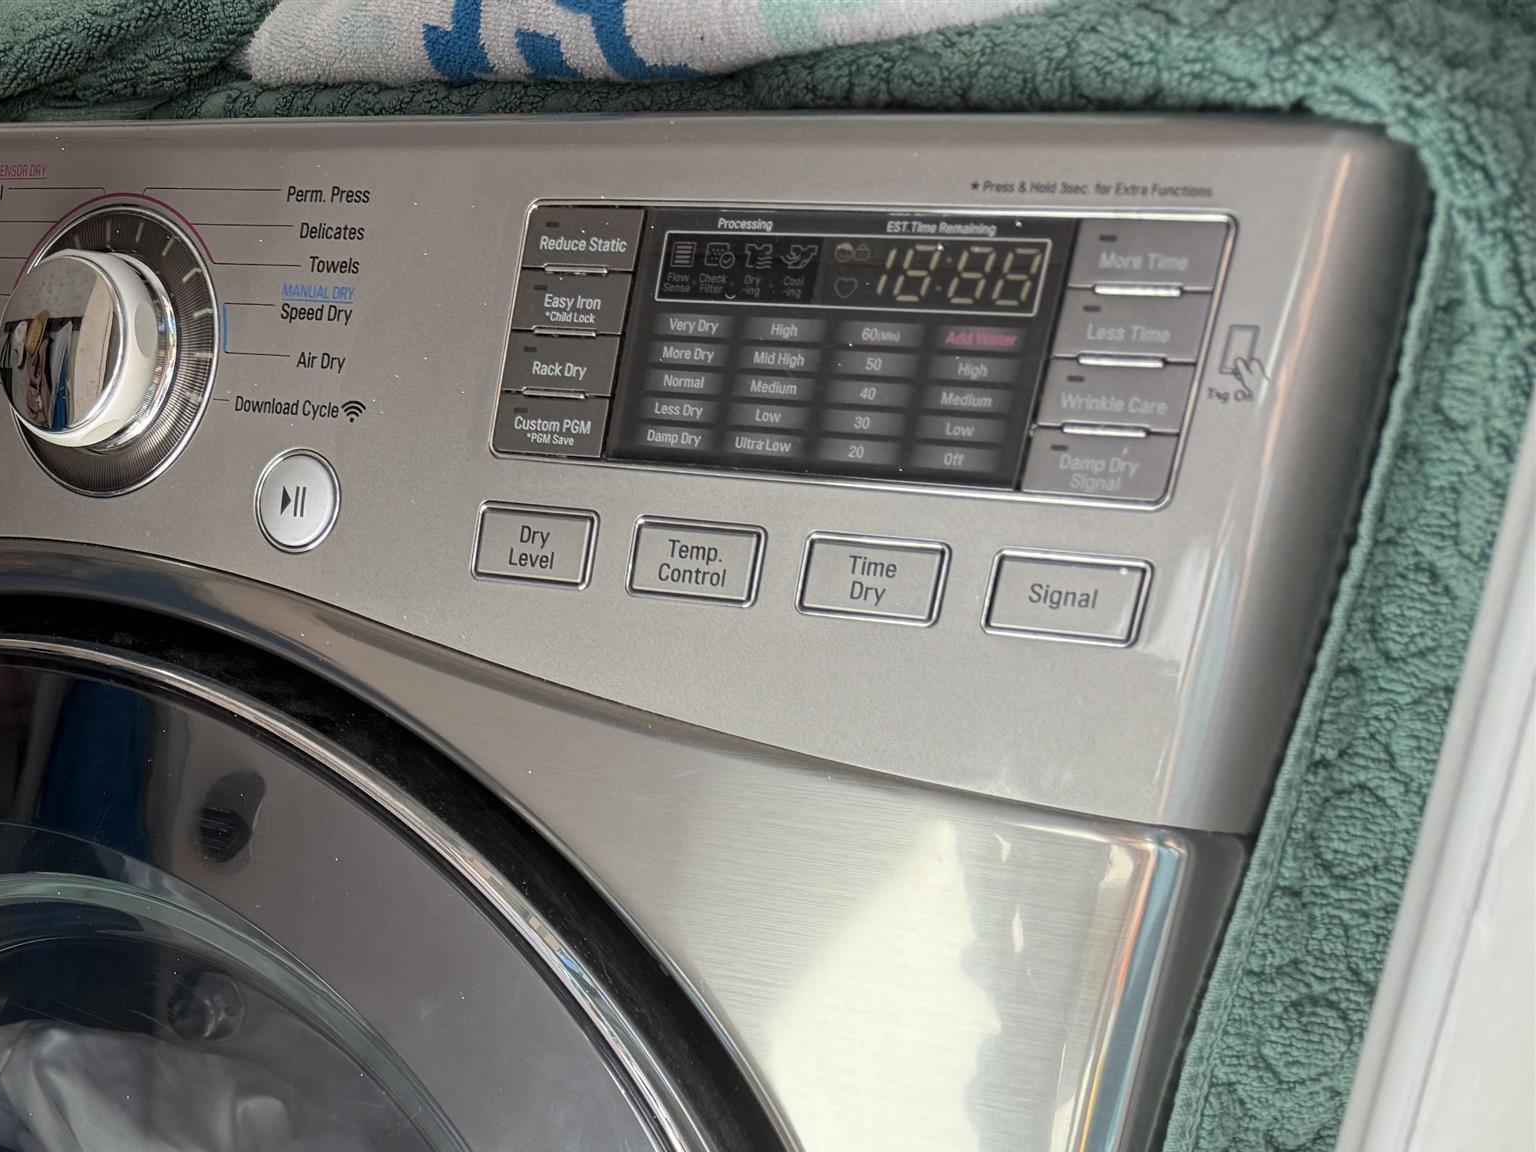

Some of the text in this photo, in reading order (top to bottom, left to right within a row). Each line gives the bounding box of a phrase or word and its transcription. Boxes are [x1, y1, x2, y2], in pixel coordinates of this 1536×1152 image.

[30, 162, 47, 177] DRY
[286, 185, 371, 204] Perm. Press
[982, 180, 1015, 193] Press
[1017, 181, 1027, 193] &
[1114, 183, 1148, 197] Extra
[1151, 183, 1213, 198] Functions
[299, 222, 366, 241] Delicates
[717, 217, 774, 233] Processing
[886, 220, 997, 237] EST. Time Remaining
[539, 235, 628, 254] Reduce Static
[309, 255, 361, 275] Towels
[1099, 251, 1189, 272] More Time
[282, 283, 356, 301] MANUAL DRY
[544, 293, 602, 311] Easy Iron
[280, 302, 353, 326] Speed Dry
[573, 311, 595, 324] Lock
[669, 318, 719, 335] Very Dry
[770, 322, 798, 341] High
[1086, 322, 1171, 343] Less Time
[296, 351, 346, 374] Air Dry
[662, 346, 714, 364] More Dry
[753, 351, 805, 369] Mid High
[531, 360, 587, 380] Rack Dry
[865, 358, 882, 372] 50
[957, 362, 989, 380] High
[663, 375, 705, 390] Normal
[750, 380, 797, 395] Medium
[859, 387, 877, 401] 40
[940, 391, 993, 407] Medium
[235, 395, 339, 420] Download Cycle
[654, 402, 704, 420] Less Dry
[1060, 392, 1168, 415] Wrinkle Care
[755, 408, 781, 423] Low
[853, 416, 871, 431] 30
[514, 415, 592, 436] Custom PGM
[945, 422, 974, 437] Low
[551, 434, 575, 446] Save
[647, 429, 702, 448] Damp Dry
[735, 435, 791, 453] Ultra Low
[848, 445, 865, 459] 20
[944, 452, 965, 467] Off
[1058, 454, 1140, 477] Damp Dry
[1070, 473, 1122, 493] Signal
[519, 525, 550, 549] Dry
[508, 548, 555, 570] Level
[668, 539, 723, 564] Temp.
[658, 563, 727, 588] Control
[849, 555, 897, 579] Time
[849, 581, 887, 607] Dry
[1028, 583, 1098, 610] Signal
